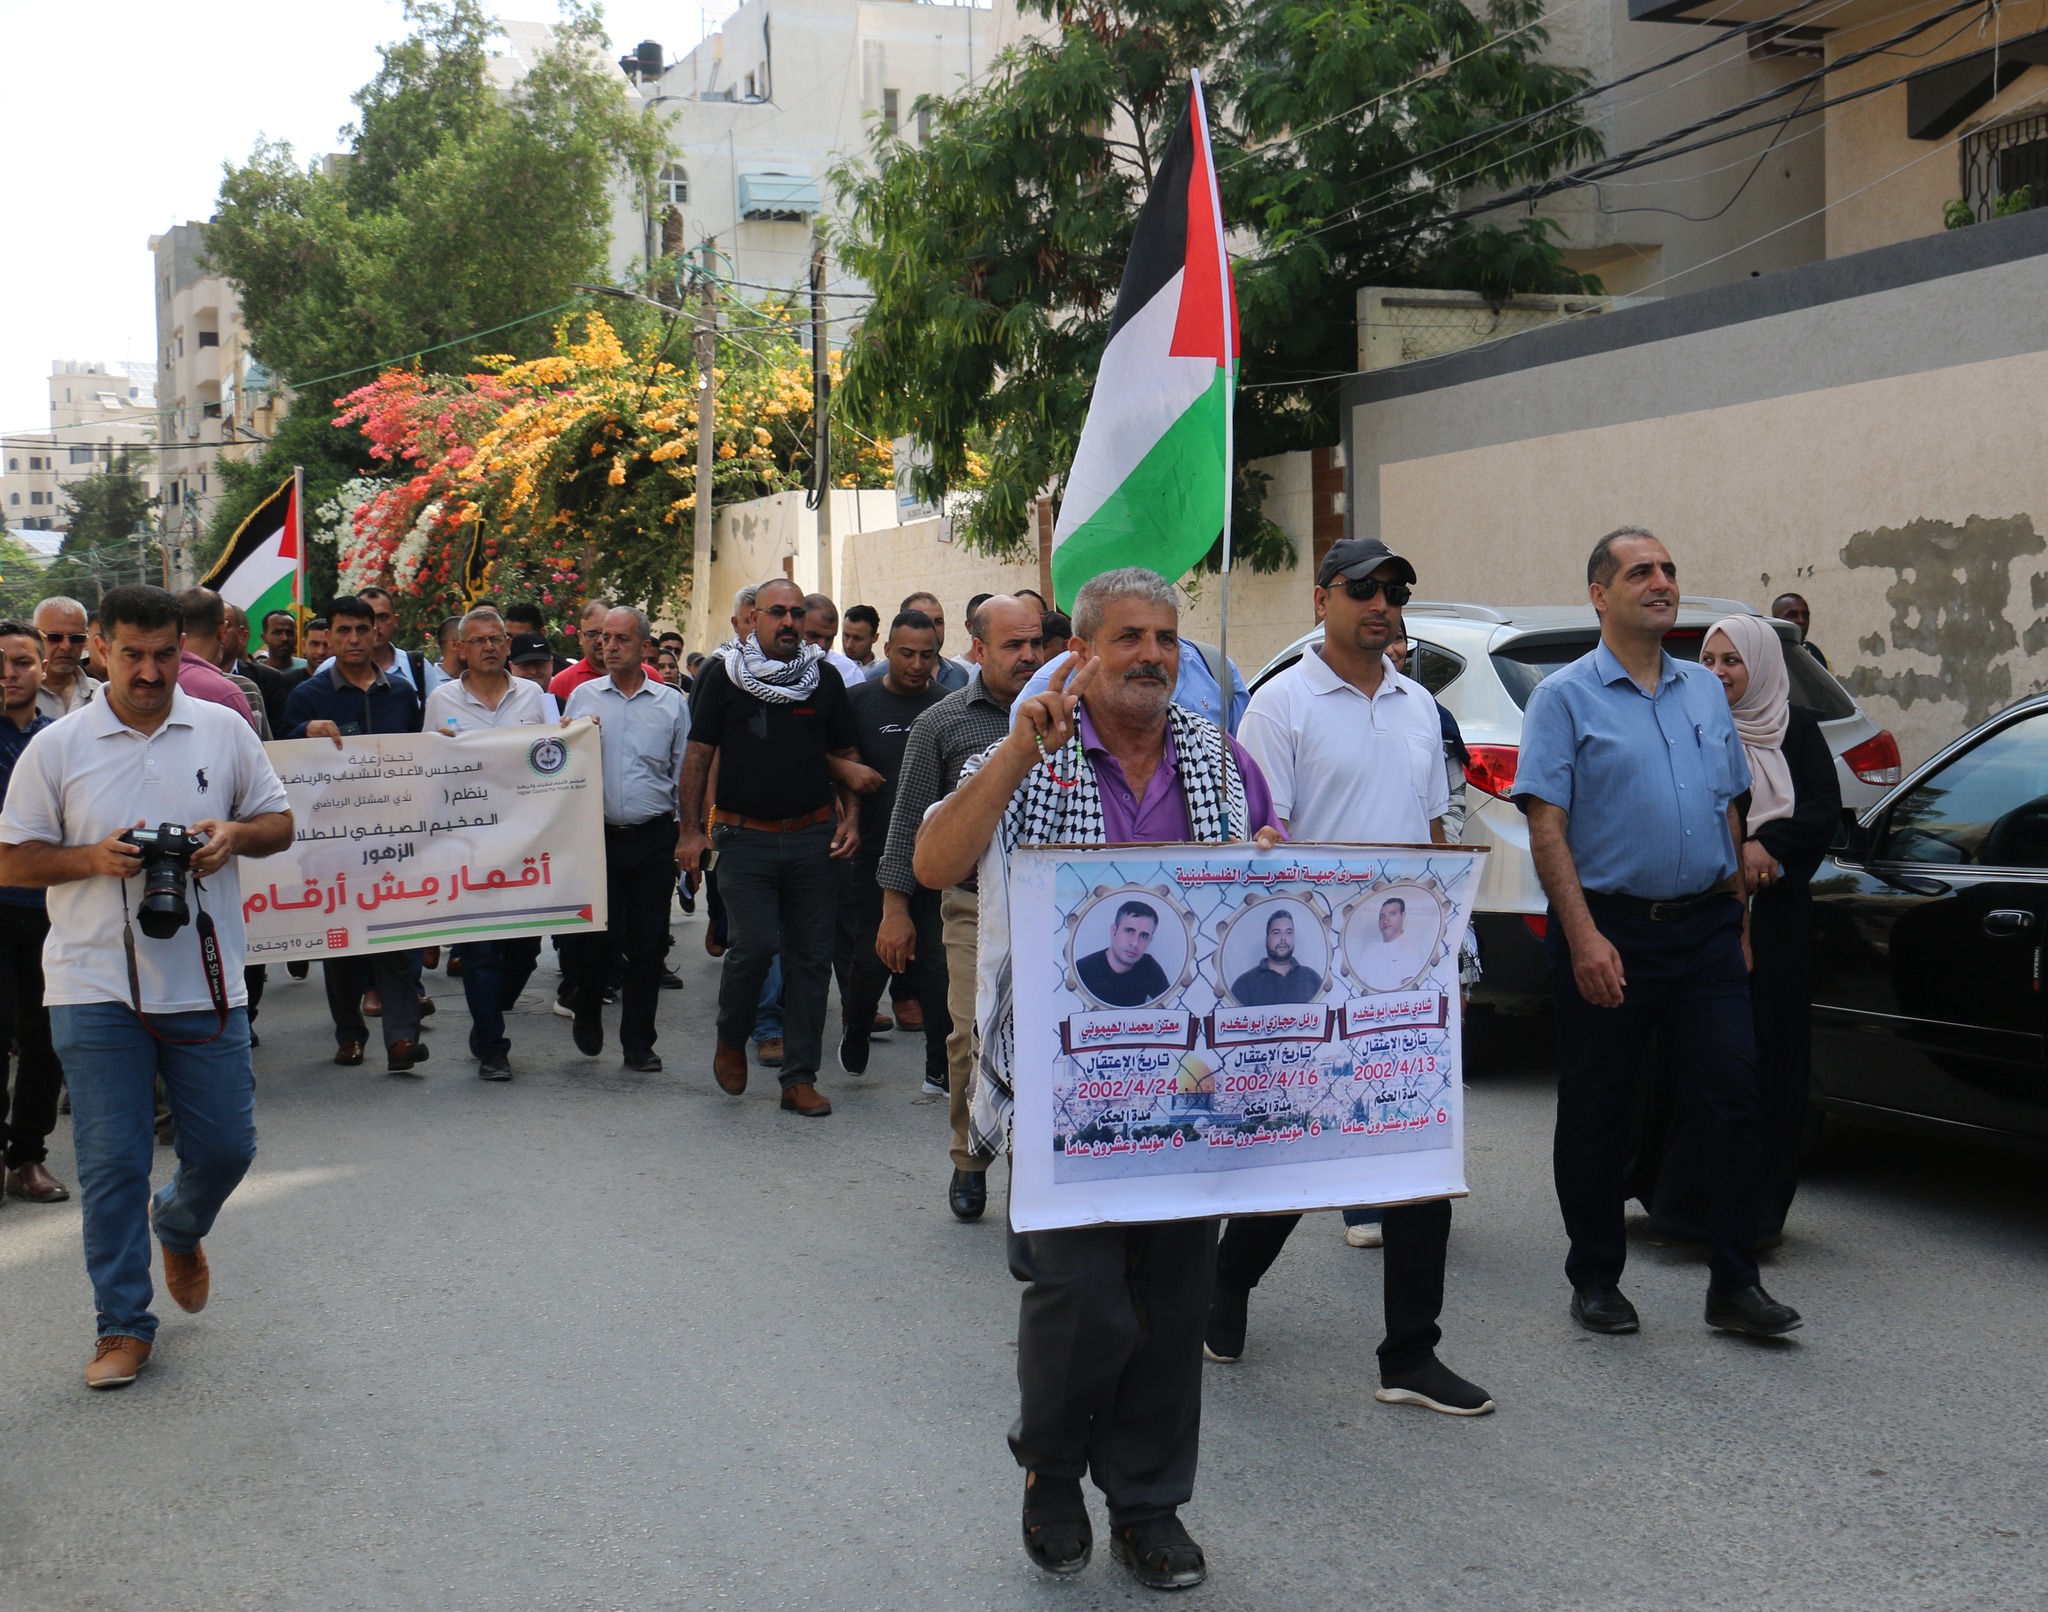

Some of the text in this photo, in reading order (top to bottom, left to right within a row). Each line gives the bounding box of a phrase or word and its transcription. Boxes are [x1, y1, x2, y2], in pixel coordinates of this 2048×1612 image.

[349, 752, 413, 766] تحت رعاية
[280, 762, 483, 786] المجلس الأعلى للشباب والرياضة
[312, 797, 351, 813] الرياضي
[354, 794, 390, 808] المشتل
[392, 793, 412, 807] نادي
[452, 786, 489, 807] ينظم
[295, 813, 498, 842] المخيم الصيفي للطلا
[362, 842, 414, 866] الزهور
[447, 852, 551, 901] أقمار
[1176, 864, 1375, 887] أسرى جبهة التحرير الفلسطينية
[242, 871, 347, 922] أرقام
[204, 936, 217, 962] EOS
[252, 941, 288, 952] وحتى
[290, 938, 302, 947] 10
[305, 938, 324, 949] من
[209, 963, 220, 976] 5D
[1352, 1004, 1375, 1021] شخدم
[1389, 1001, 1410, 1018] غالب
[1411, 997, 1433, 1016] شادي
[1080, 1019, 1180, 1040] معتز محمد الهيموني
[1219, 1015, 1249, 1032] شخدم
[1251, 1014, 1265, 1033] أبو
[1265, 1015, 1297, 1032] حجازي
[1362, 1032, 1428, 1057] تاريخ الإعتقال
[1086, 1052, 1170, 1073] تاريخ الإعتقال
[1234, 1045, 1312, 1067] تاريخ الإعتقال
[1353, 1056, 1436, 1081] 2002/4/13
[1078, 1077, 1179, 1099] 2002/4/24
[1224, 1069, 1319, 1093] 2002/4/16
[1374, 1087, 1418, 1106] مدة الحكم
[1098, 1108, 1151, 1127] مدة الحكم
[1242, 1100, 1292, 1118] مدة الحكم
[1436, 1107, 1447, 1123] 6
[1310, 1120, 1321, 1137] 6
[1366, 1115, 1407, 1135] وعشرون
[1408, 1112, 1430, 1129] مؤبد
[1172, 1130, 1184, 1148] 6
[1236, 1126, 1278, 1148] وعشرون
[1280, 1124, 1303, 1142] مؤبد
[1093, 1135, 1137, 1157] وعشرون
[1139, 1134, 1165, 1152] مؤبد
